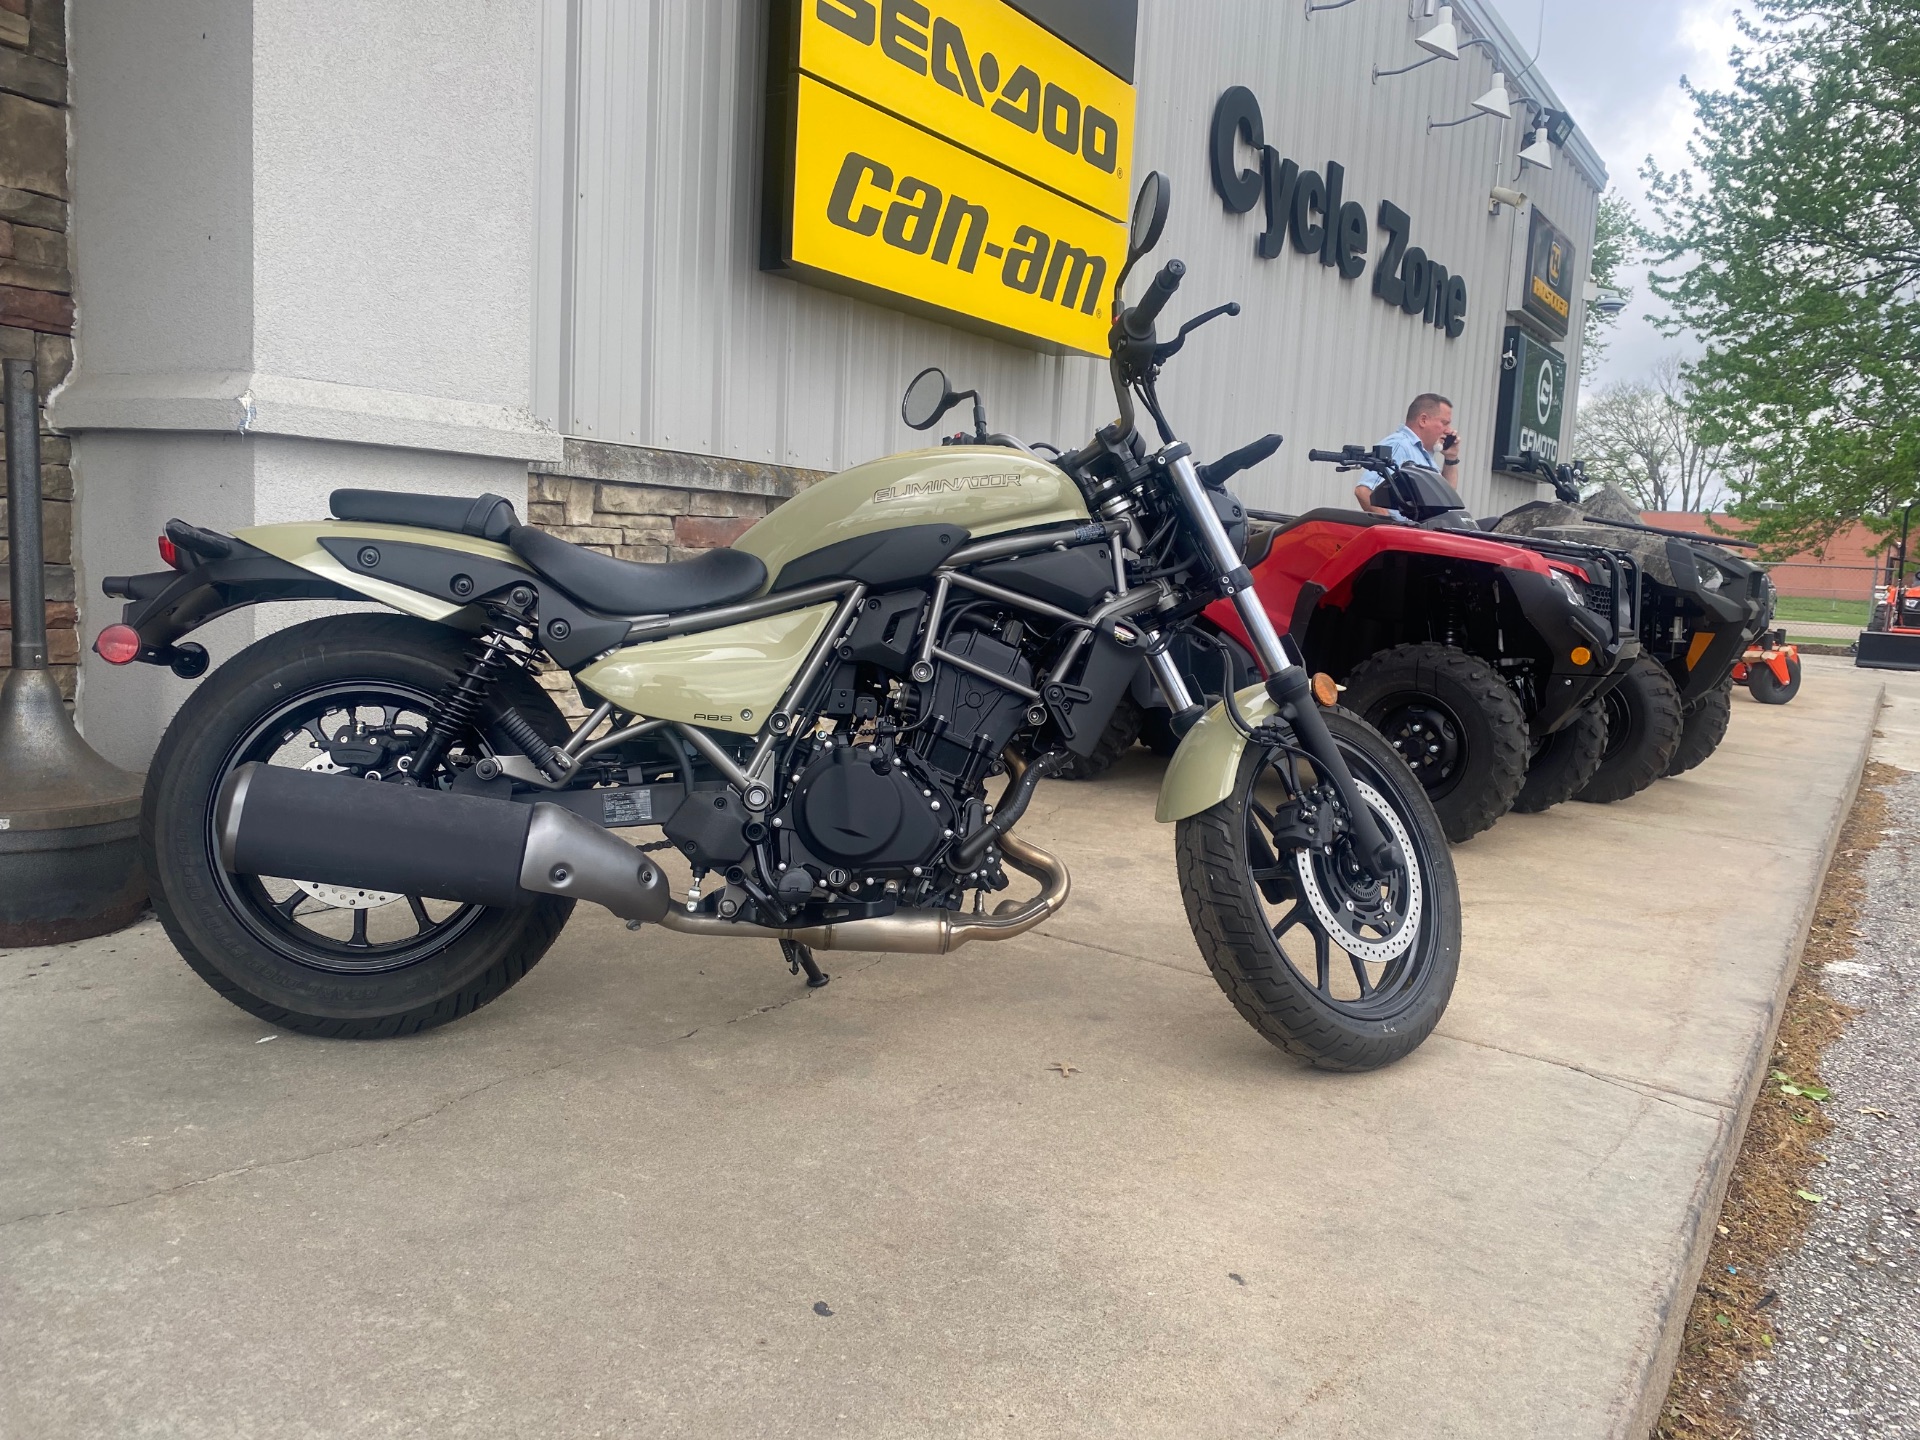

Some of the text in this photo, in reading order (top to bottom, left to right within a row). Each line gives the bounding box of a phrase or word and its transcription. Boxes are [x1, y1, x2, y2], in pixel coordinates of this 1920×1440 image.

[1210, 85, 1467, 338] Cycle Zone
[1520, 426, 1558, 462] CFMOTO
[873, 474, 1021, 503] ELIMINATOR
[693, 713, 733, 722] ABS
